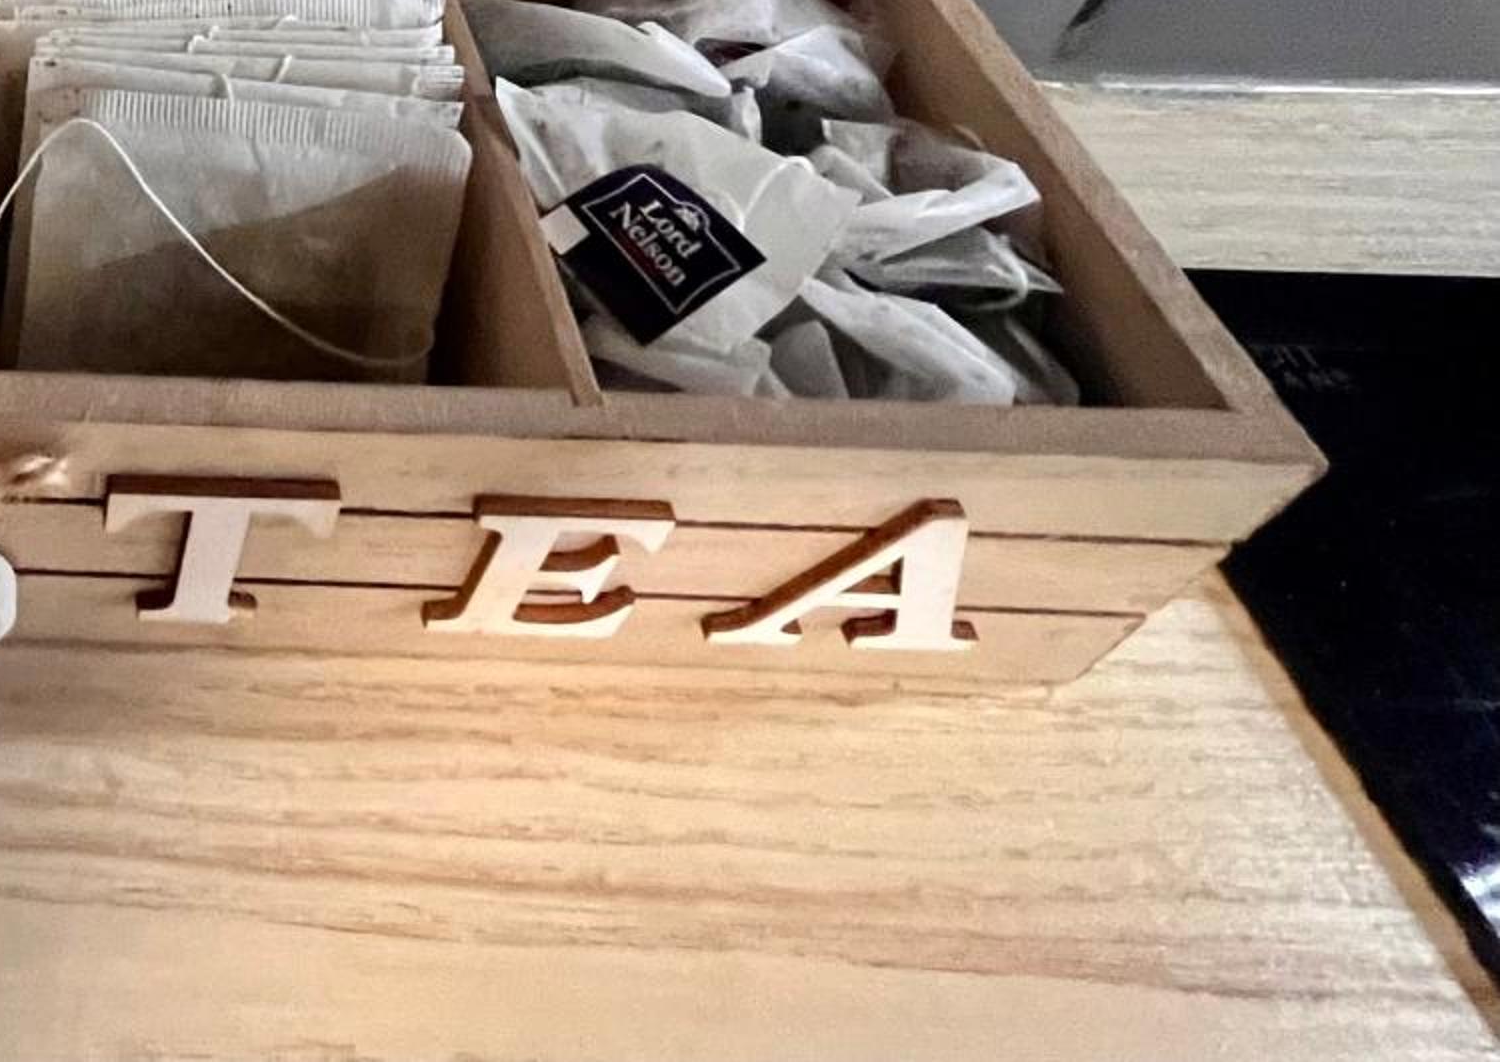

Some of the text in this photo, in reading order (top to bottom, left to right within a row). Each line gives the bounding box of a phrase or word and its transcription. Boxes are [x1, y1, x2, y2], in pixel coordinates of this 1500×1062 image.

[607, 202, 687, 287] Nelson
[639, 199, 703, 260] Lord
[103, 473, 980, 651] TEA
